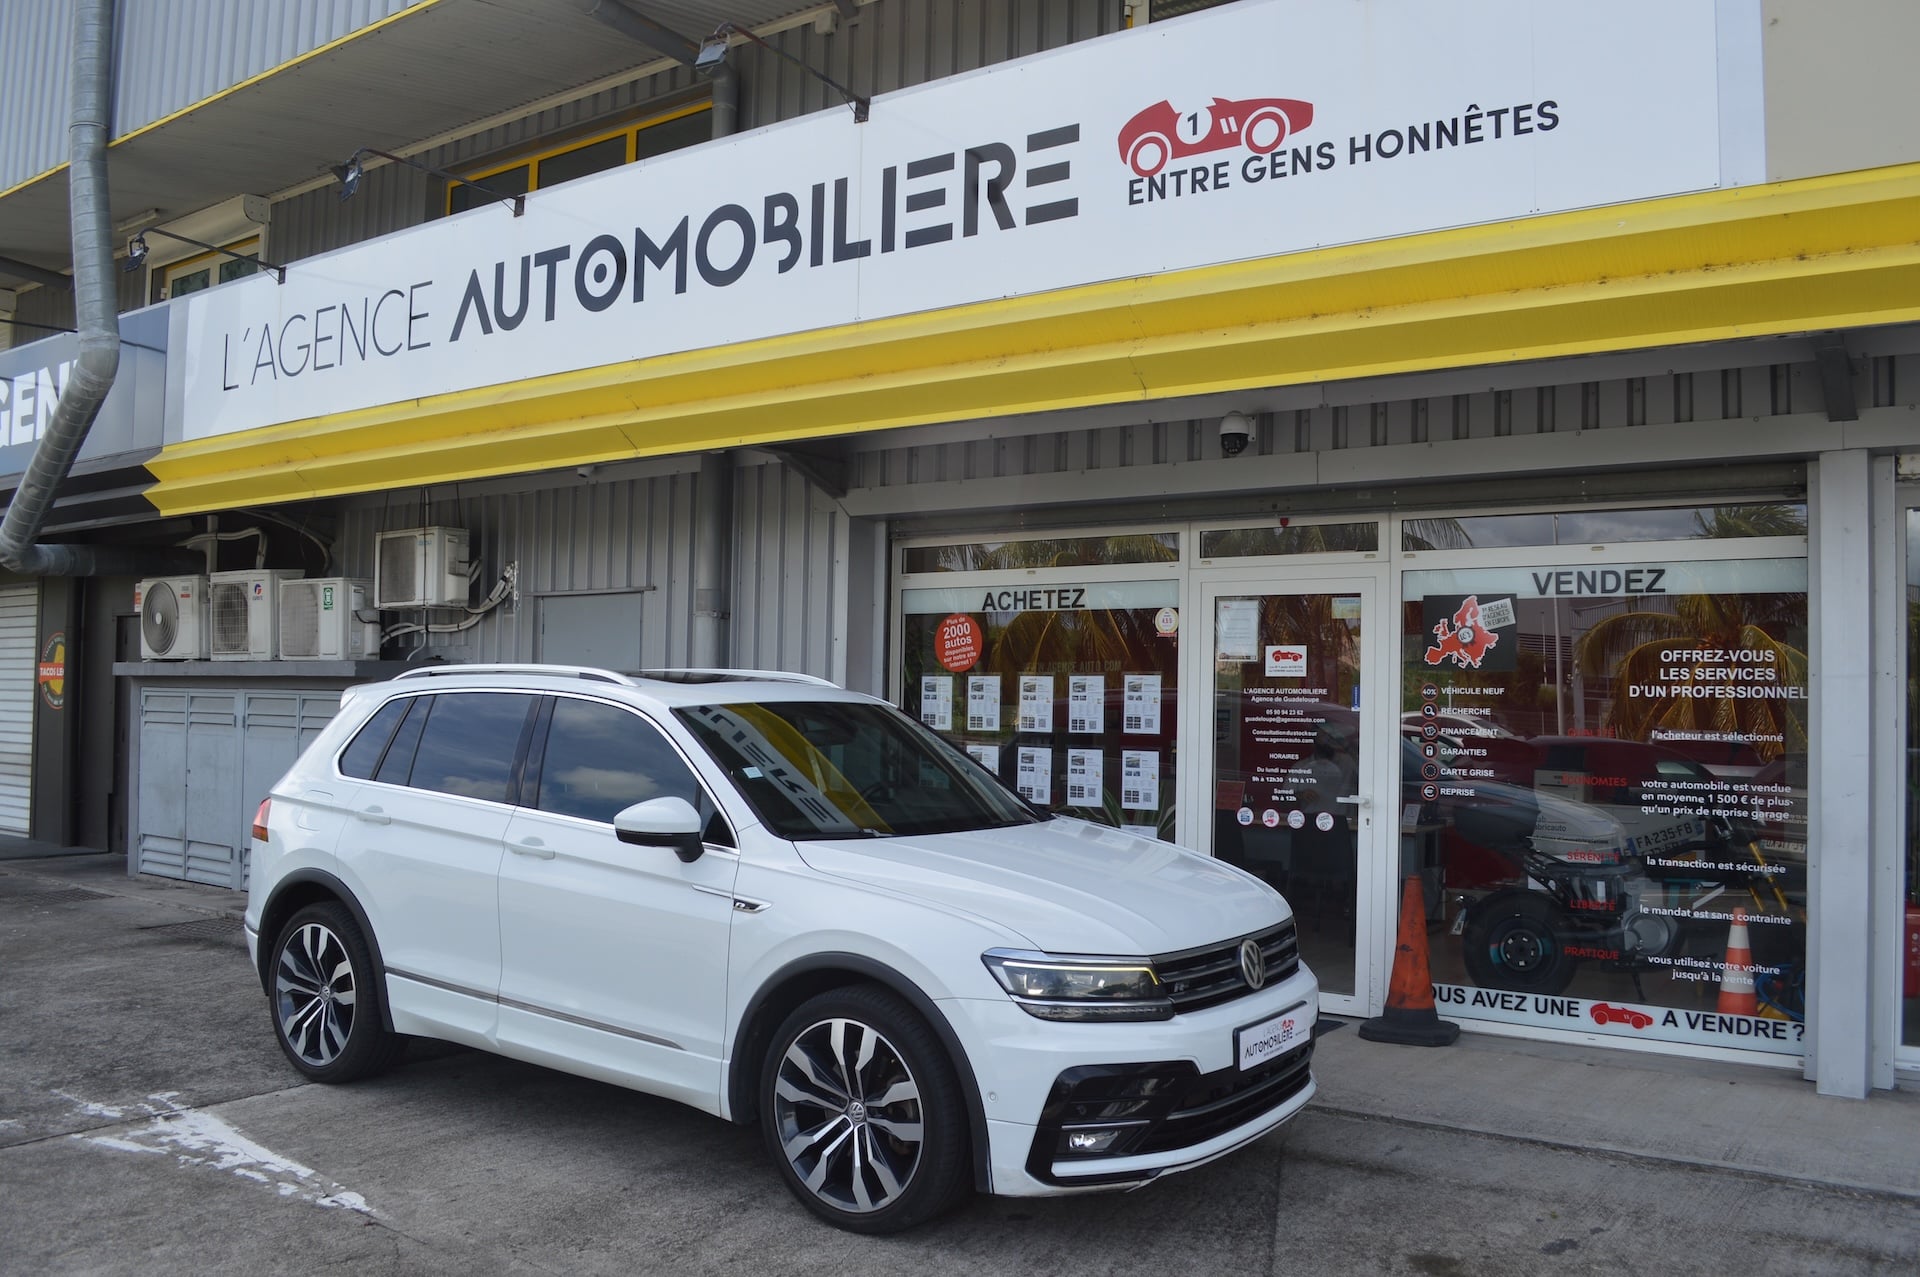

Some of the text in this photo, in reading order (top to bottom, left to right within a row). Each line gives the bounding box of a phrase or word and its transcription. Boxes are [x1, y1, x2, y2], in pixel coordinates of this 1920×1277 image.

[1128, 100, 1560, 206] ENTRE GENS HONNÊTES
[222, 123, 1080, 392] L'AGENCE AUTOMOBILIERE
[1532, 568, 1666, 595] VENDEZ
[981, 588, 1085, 611] ACHETEZ
[943, 622, 970, 639] 2000
[944, 635, 972, 649] autos
[1660, 649, 1775, 663] OFFREZ-VOUS
[39, 667, 56, 676] TACOS
[1659, 667, 1776, 681] LES SERVICES
[1483, 687, 1505, 695] NEUF
[1629, 685, 1808, 699] D'UN PROFESSIONNEL
[1440, 707, 1491, 715] RECHERCHE
[1440, 727, 1499, 736] FINANCEMENT
[1651, 729, 1784, 743] l'acheteur est sélectionné
[1440, 748, 1487, 756] GARANTIES
[1440, 768, 1495, 777] CARTE GRISE
[1440, 788, 1475, 796] REPRISE
[1641, 780, 1792, 793] votre automobile est vendue
[1641, 793, 1654, 801] en
[1656, 793, 1705, 804] moyenne
[1707, 794, 1713, 803] 1
[1717, 794, 1738, 805] 500
[1741, 795, 1748, 805] €
[1750, 795, 1765, 805] de
[1641, 804, 1671, 816] qu'un
[1673, 805, 1694, 816] prix
[1696, 806, 1710, 816] de
[1712, 807, 1749, 819] reprise
[1751, 811, 1790, 821] garage
[1646, 856, 1786, 874] la transaction est sécurisée
[1640, 904, 1792, 925] le mandat est sans contrainte
[1564, 946, 1621, 960] PRATIQUE
[1647, 956, 1780, 975] vous utilisez votre voiture
[1672, 969, 1754, 985] jusqu'à la vente
[1471, 990, 1528, 1013] AVEZ
[1534, 997, 1581, 1018] UNE
[1661, 1010, 1805, 1042] A VENDRE ?
